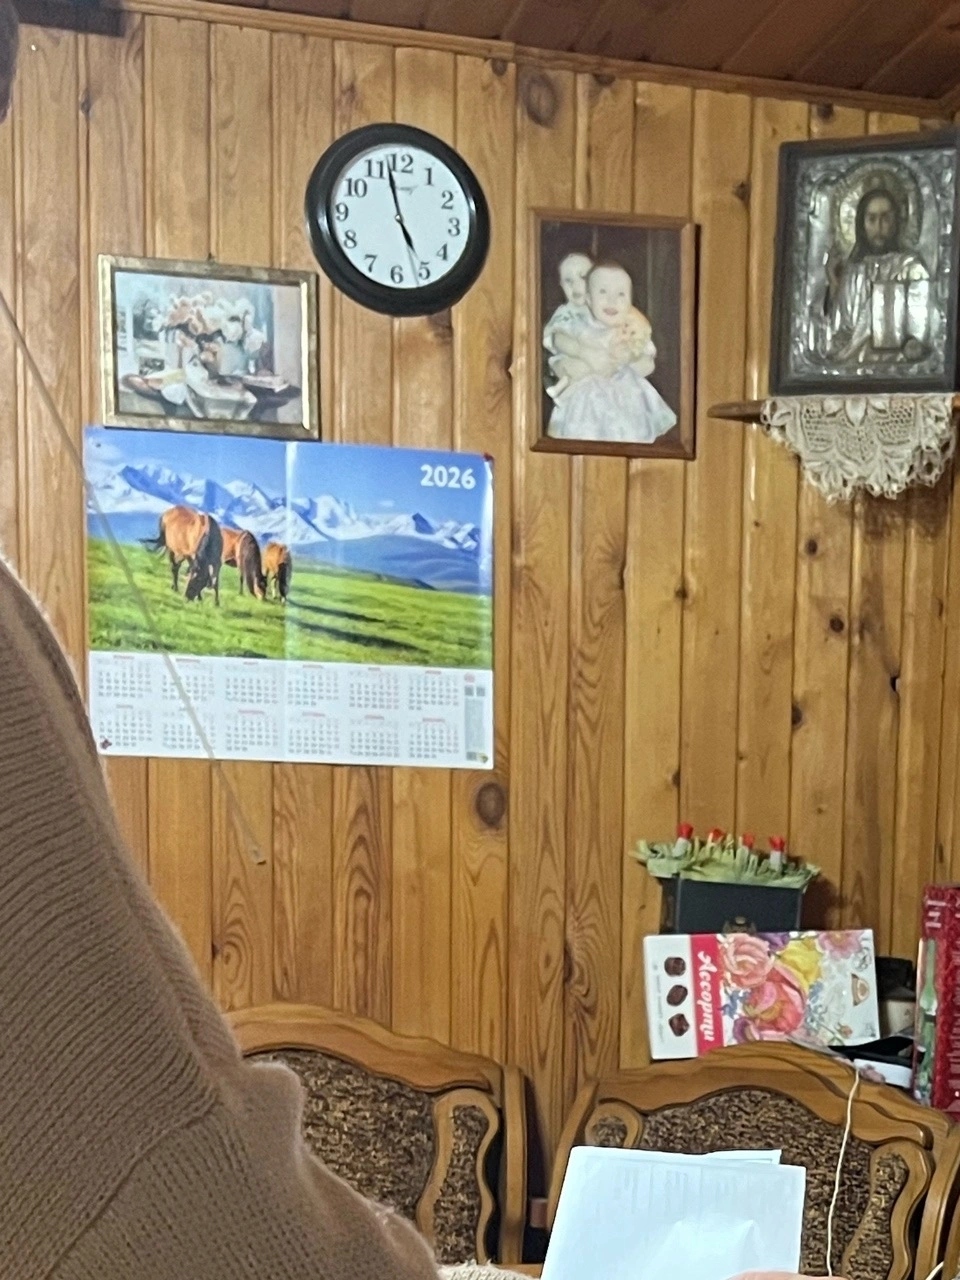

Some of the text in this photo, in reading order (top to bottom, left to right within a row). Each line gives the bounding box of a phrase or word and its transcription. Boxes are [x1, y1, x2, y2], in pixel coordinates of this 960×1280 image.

[365, 159, 385, 179] 11
[391, 153, 414, 173] 12
[425, 168, 434, 186] 1
[344, 178, 367, 197] 10
[441, 191, 454, 210] 2
[336, 203, 349, 222] 9
[447, 218, 460, 237] 3
[343, 230, 357, 249] 8
[436, 243, 448, 261] 4
[364, 254, 377, 273] 7
[418, 262, 431, 280] 5
[390, 265, 404, 284] 6
[420, 464, 476, 490] 2026
[697, 950, 718, 1041] Ассорти
